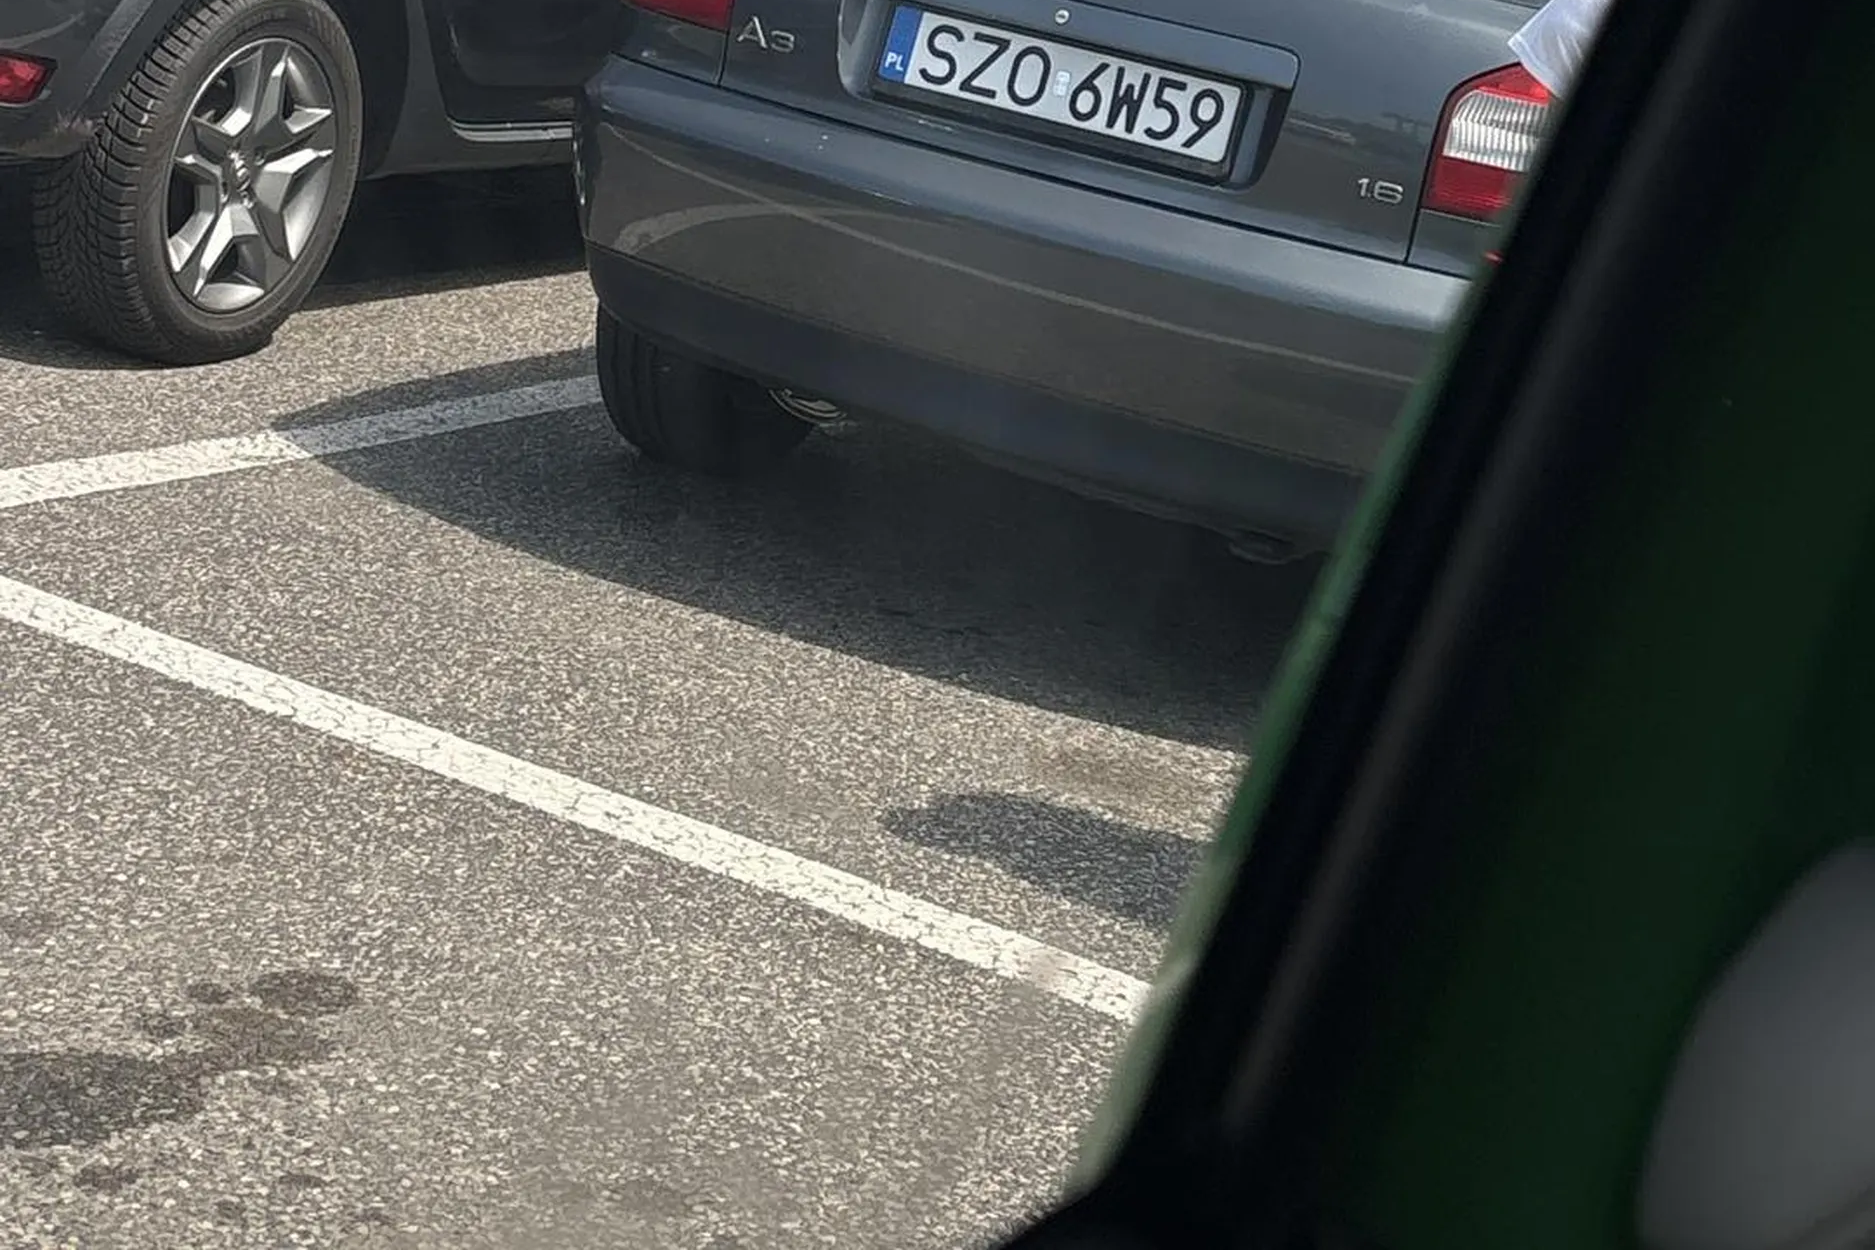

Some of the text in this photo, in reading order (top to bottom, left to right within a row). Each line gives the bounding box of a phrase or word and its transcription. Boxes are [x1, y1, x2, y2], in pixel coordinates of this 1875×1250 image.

[736, 15, 796, 53] A3
[884, 52, 904, 71] PL
[919, 24, 1225, 150] SZO 6W59
